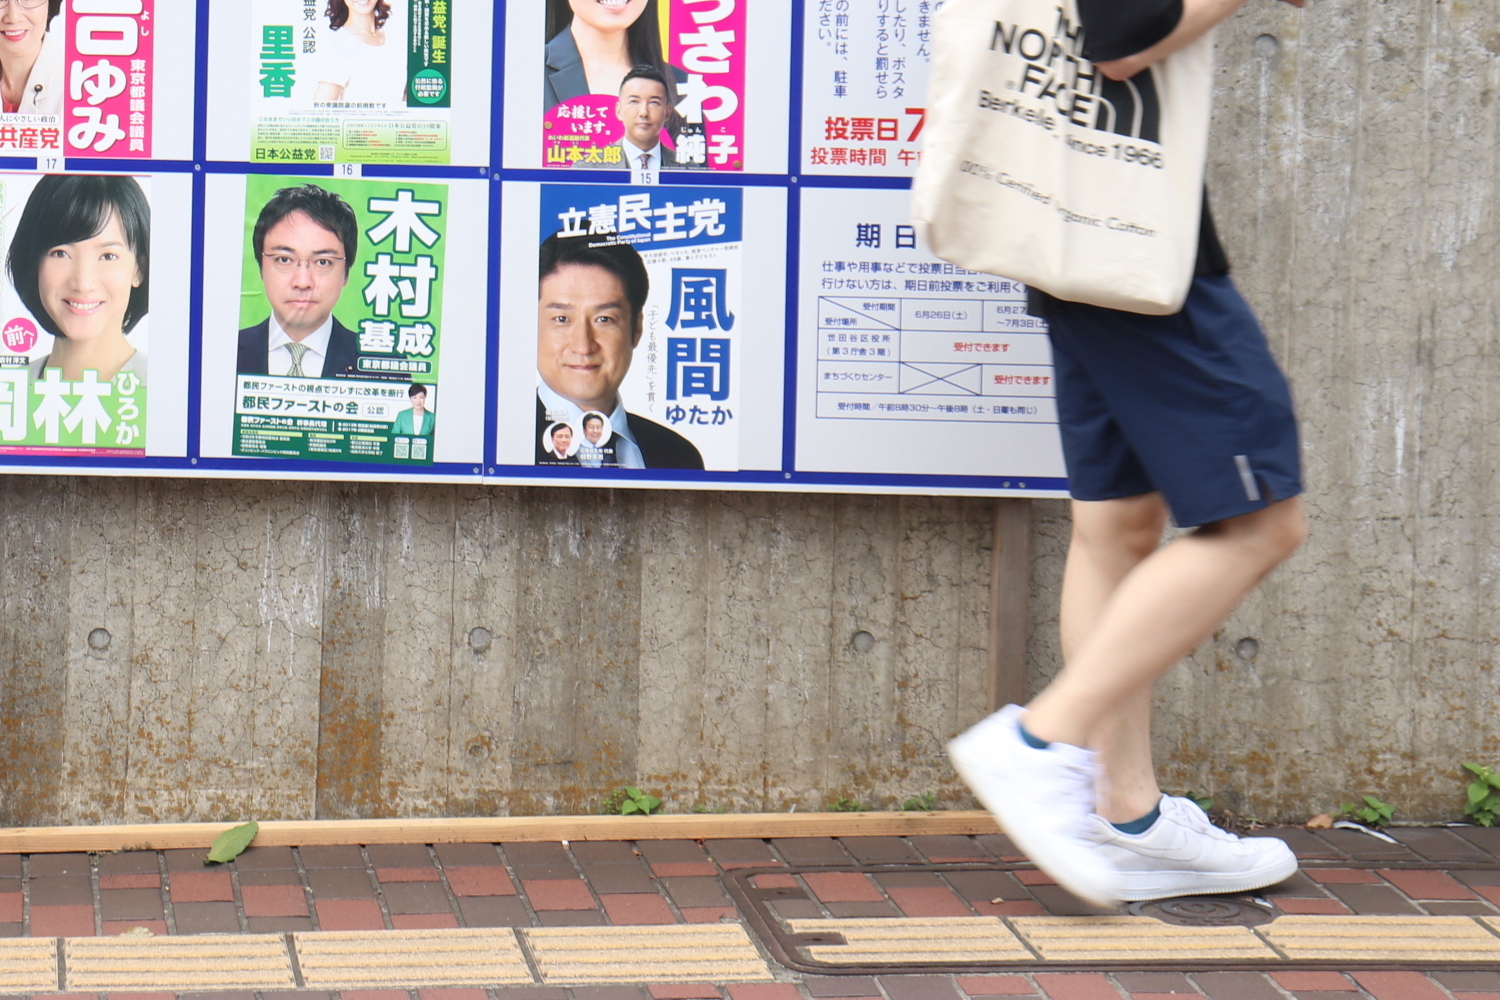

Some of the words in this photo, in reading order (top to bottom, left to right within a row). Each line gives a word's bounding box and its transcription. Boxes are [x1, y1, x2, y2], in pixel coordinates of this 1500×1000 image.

[140, 11, 150, 36] よし
[259, 24, 297, 99] 里香
[129, 59, 146, 152] 東京都議会議員
[556, 104, 609, 120] 応援して
[570, 121, 611, 136] います。
[255, 147, 317, 161] 日本公益党
[546, 144, 622, 164] 山本太郎
[675, 134, 739, 164] 純子
[810, 147, 887, 167] 投票時間
[46, 159, 57, 170] 17
[341, 164, 353, 176] 16
[640, 173, 652, 184] 15
[556, 192, 727, 242] 立憲民主党
[856, 223, 916, 249] 期日
[364, 189, 441, 318] 木村
[863, 302, 896, 312] 受付期間
[825, 317, 858, 327] 受付場所
[3, 325, 35, 349] 前へ！
[358, 320, 434, 357] 基成
[665, 267, 735, 402] 風間
[827, 333, 892, 344] 世田谷区役所
[953, 342, 1011, 354] 受付できます
[362, 359, 427, 373] 東京都議会議員
[824, 372, 893, 382] まちづくりセンター
[993, 374, 1051, 386] 受付できます
[243, 381, 405, 398] 都民ファーストの視点でブレずに改革を断行
[115, 371, 141, 445] ひろか
[242, 395, 359, 415] 都民ファーストの会
[367, 406, 384, 415] 公認
[665, 405, 733, 426] ゆたか
